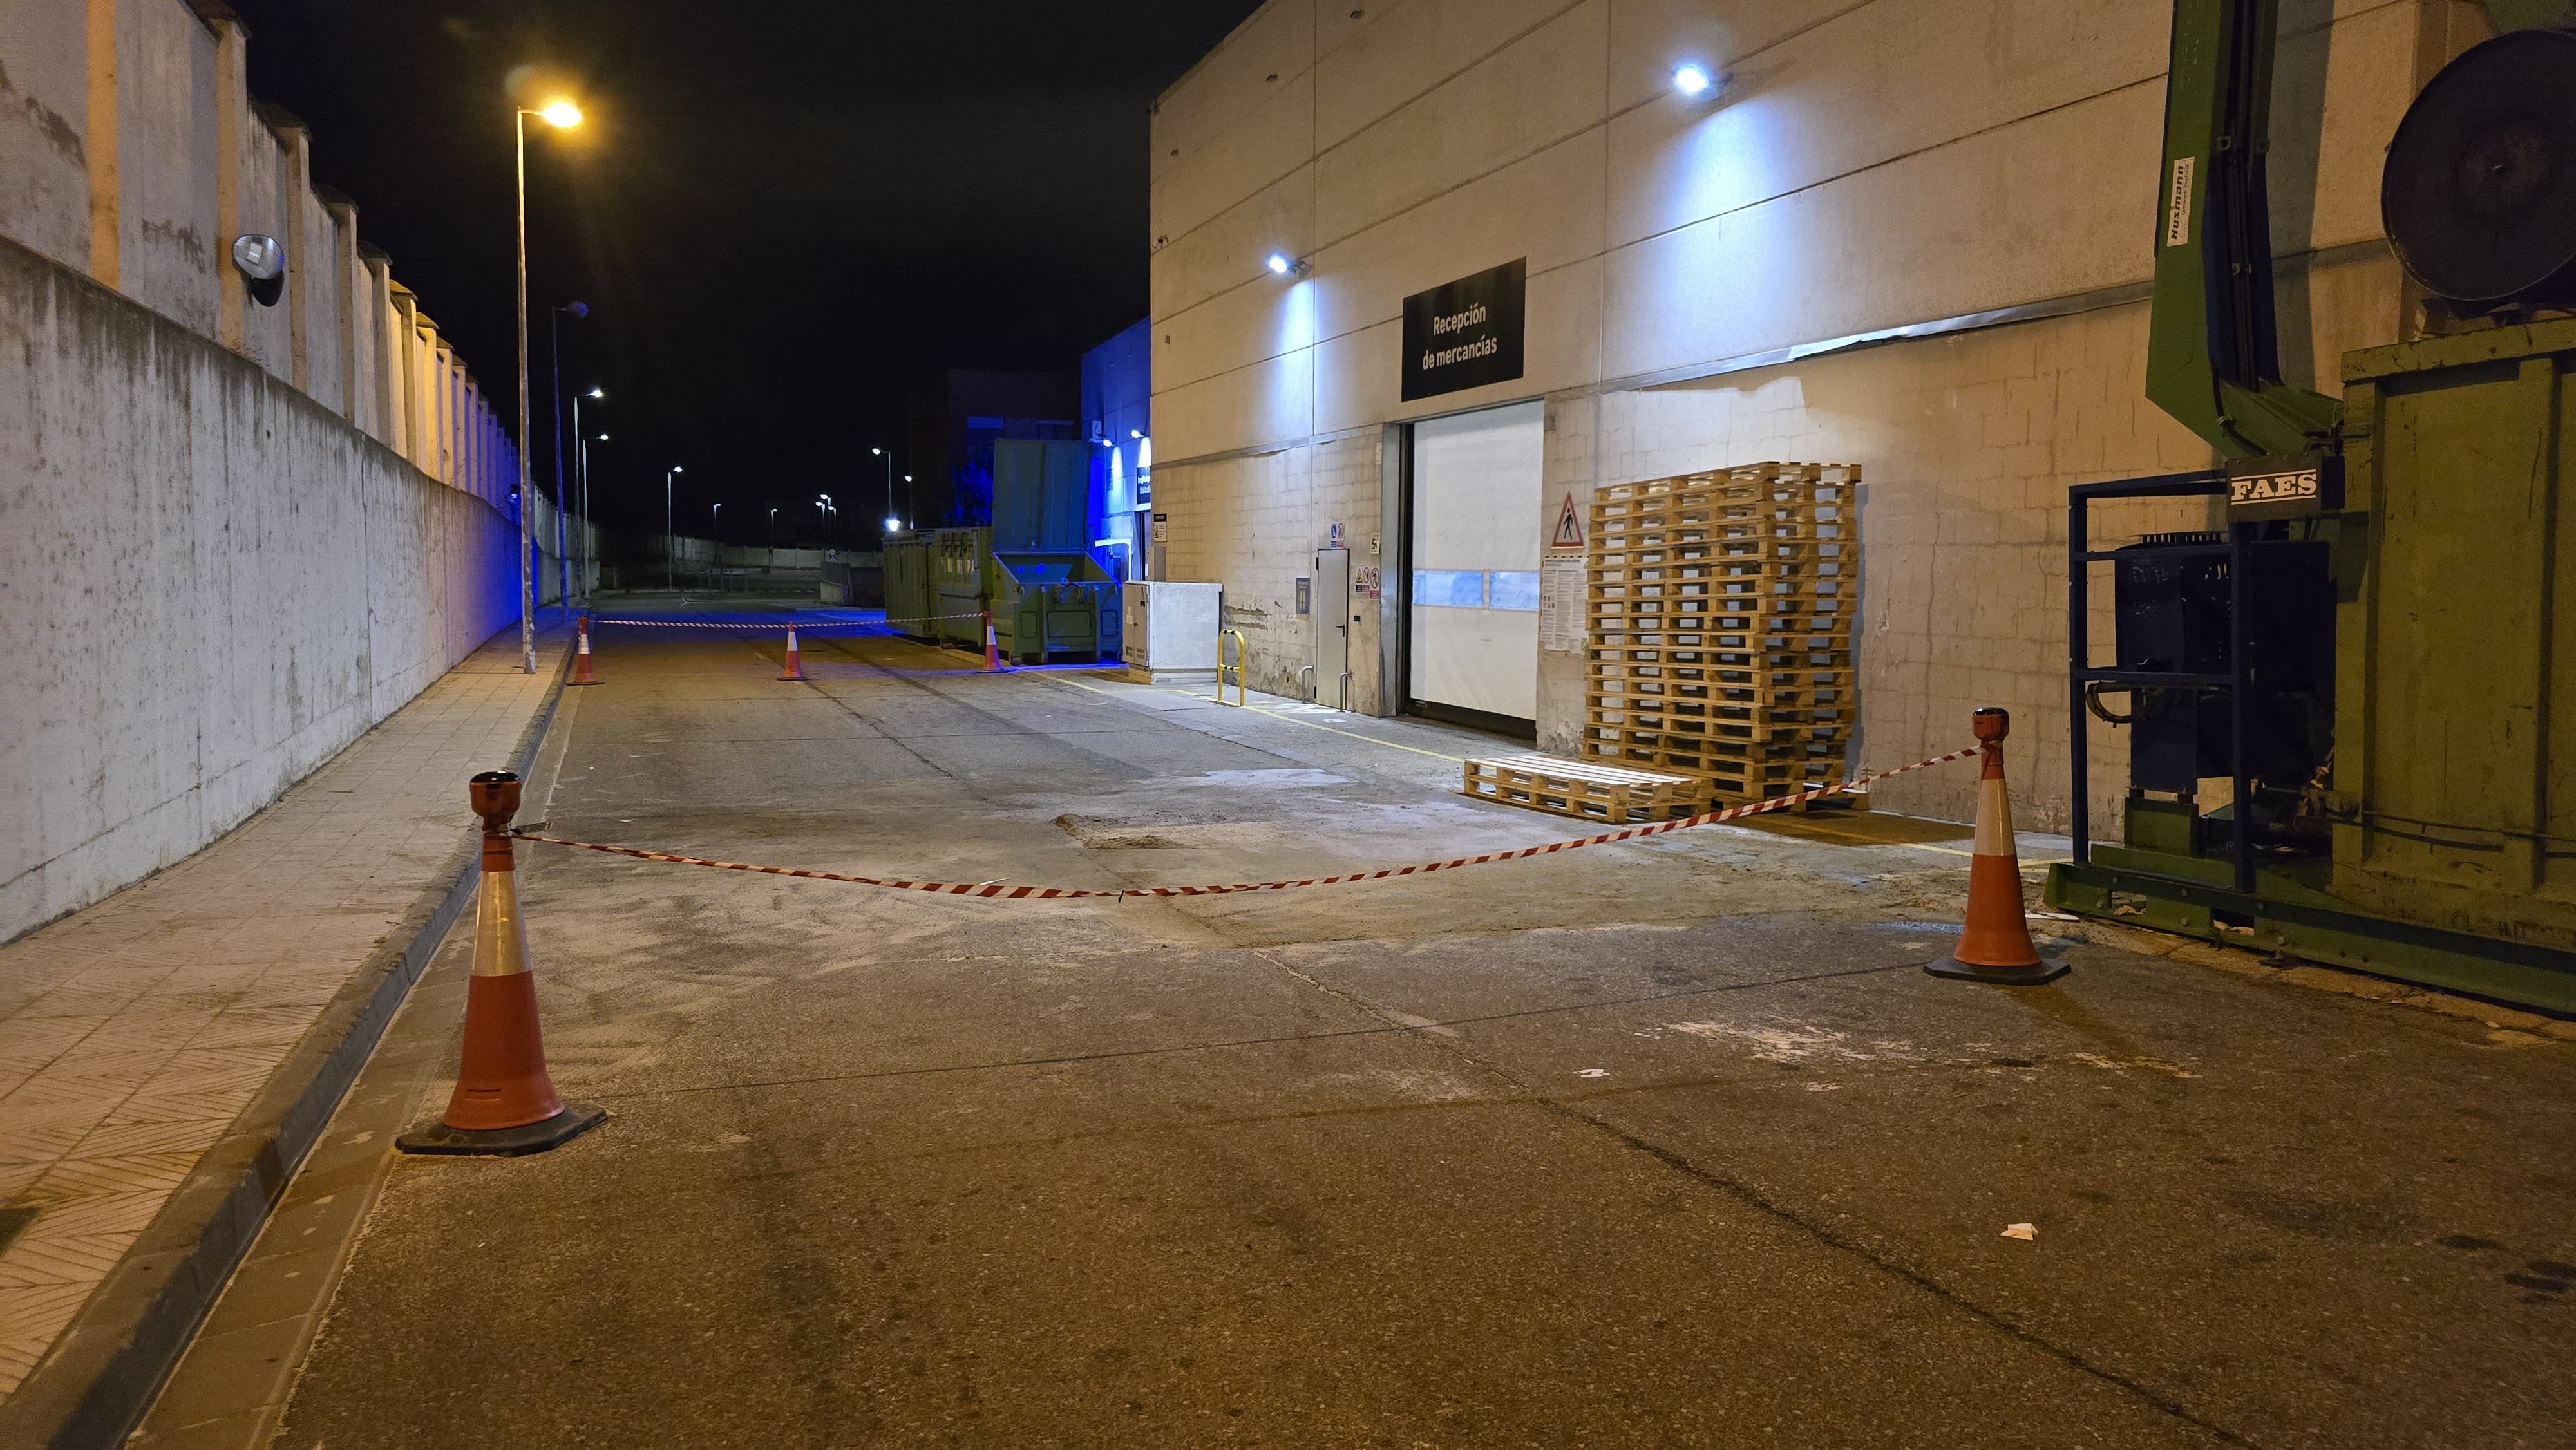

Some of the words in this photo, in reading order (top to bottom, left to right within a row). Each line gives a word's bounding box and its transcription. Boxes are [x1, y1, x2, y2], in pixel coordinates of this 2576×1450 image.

[2170, 165, 2184, 240] Husmann
[1434, 302, 1486, 335] Recepción
[1422, 350, 1435, 370] de
[1436, 334, 1497, 367] mercancías
[2231, 473, 2316, 501] FAES
